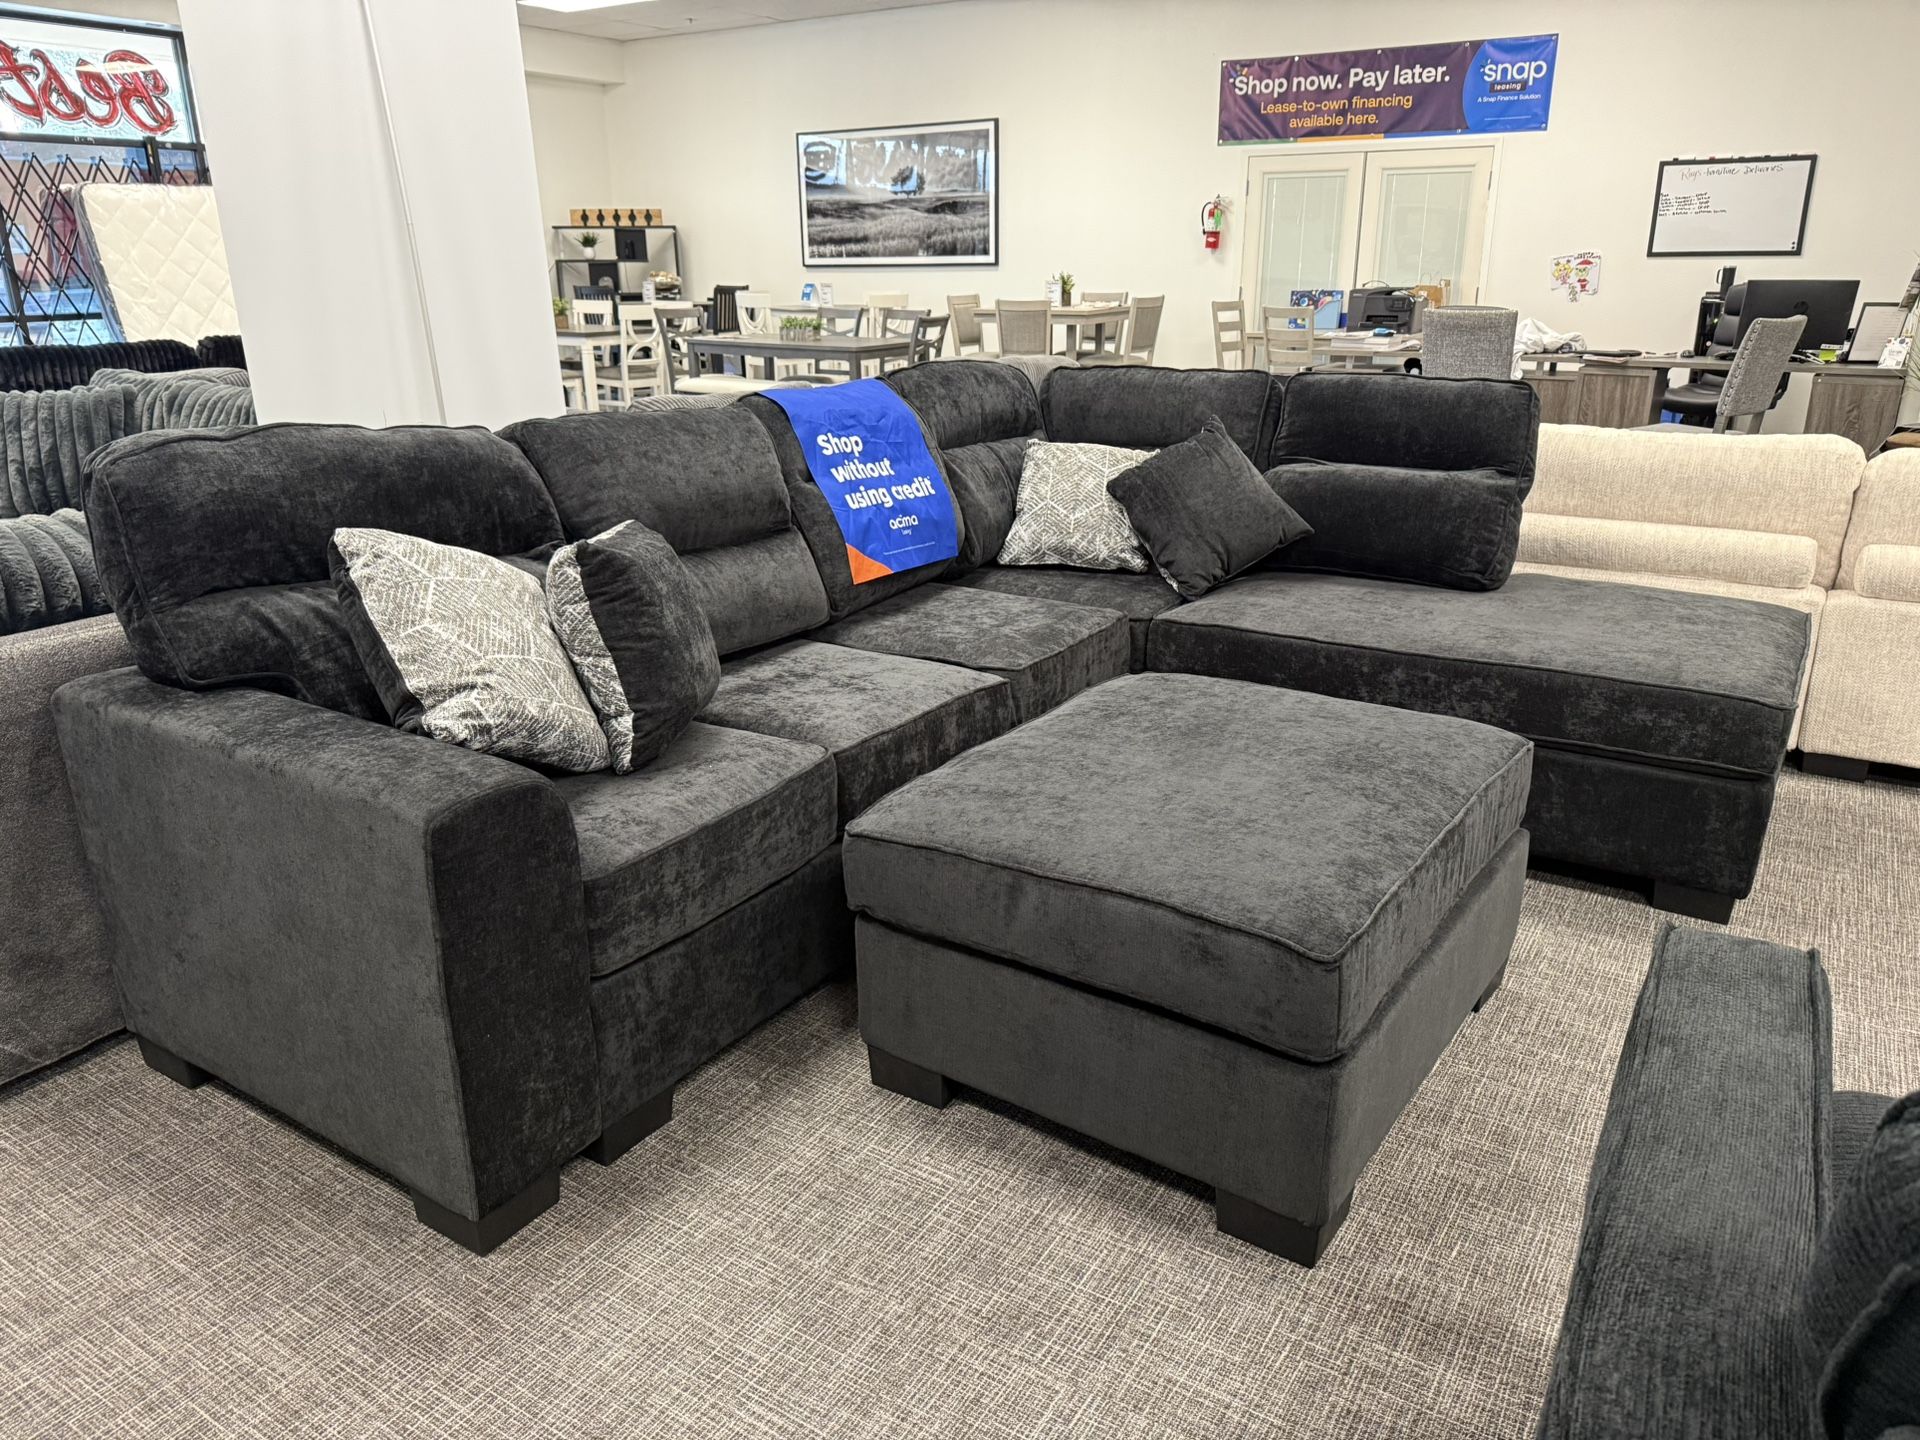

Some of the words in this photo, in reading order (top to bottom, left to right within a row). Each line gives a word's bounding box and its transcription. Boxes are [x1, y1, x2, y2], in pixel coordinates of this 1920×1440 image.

[1234, 76, 1288, 98] Shop
[1292, 74, 1342, 92] now.
[1348, 68, 1389, 91] Pay
[1393, 64, 1450, 85] later.
[1483, 60, 1547, 86] snap
[1494, 83, 1521, 91] leasing
[1260, 99, 1348, 114] Lease-to-own
[1352, 93, 1412, 109] financing
[1289, 113, 1344, 129] available
[1346, 112, 1379, 126] here.
[816, 432, 863, 457] Shop
[830, 457, 895, 483] without
[844, 485, 894, 510] using
[890, 476, 936, 500] credit
